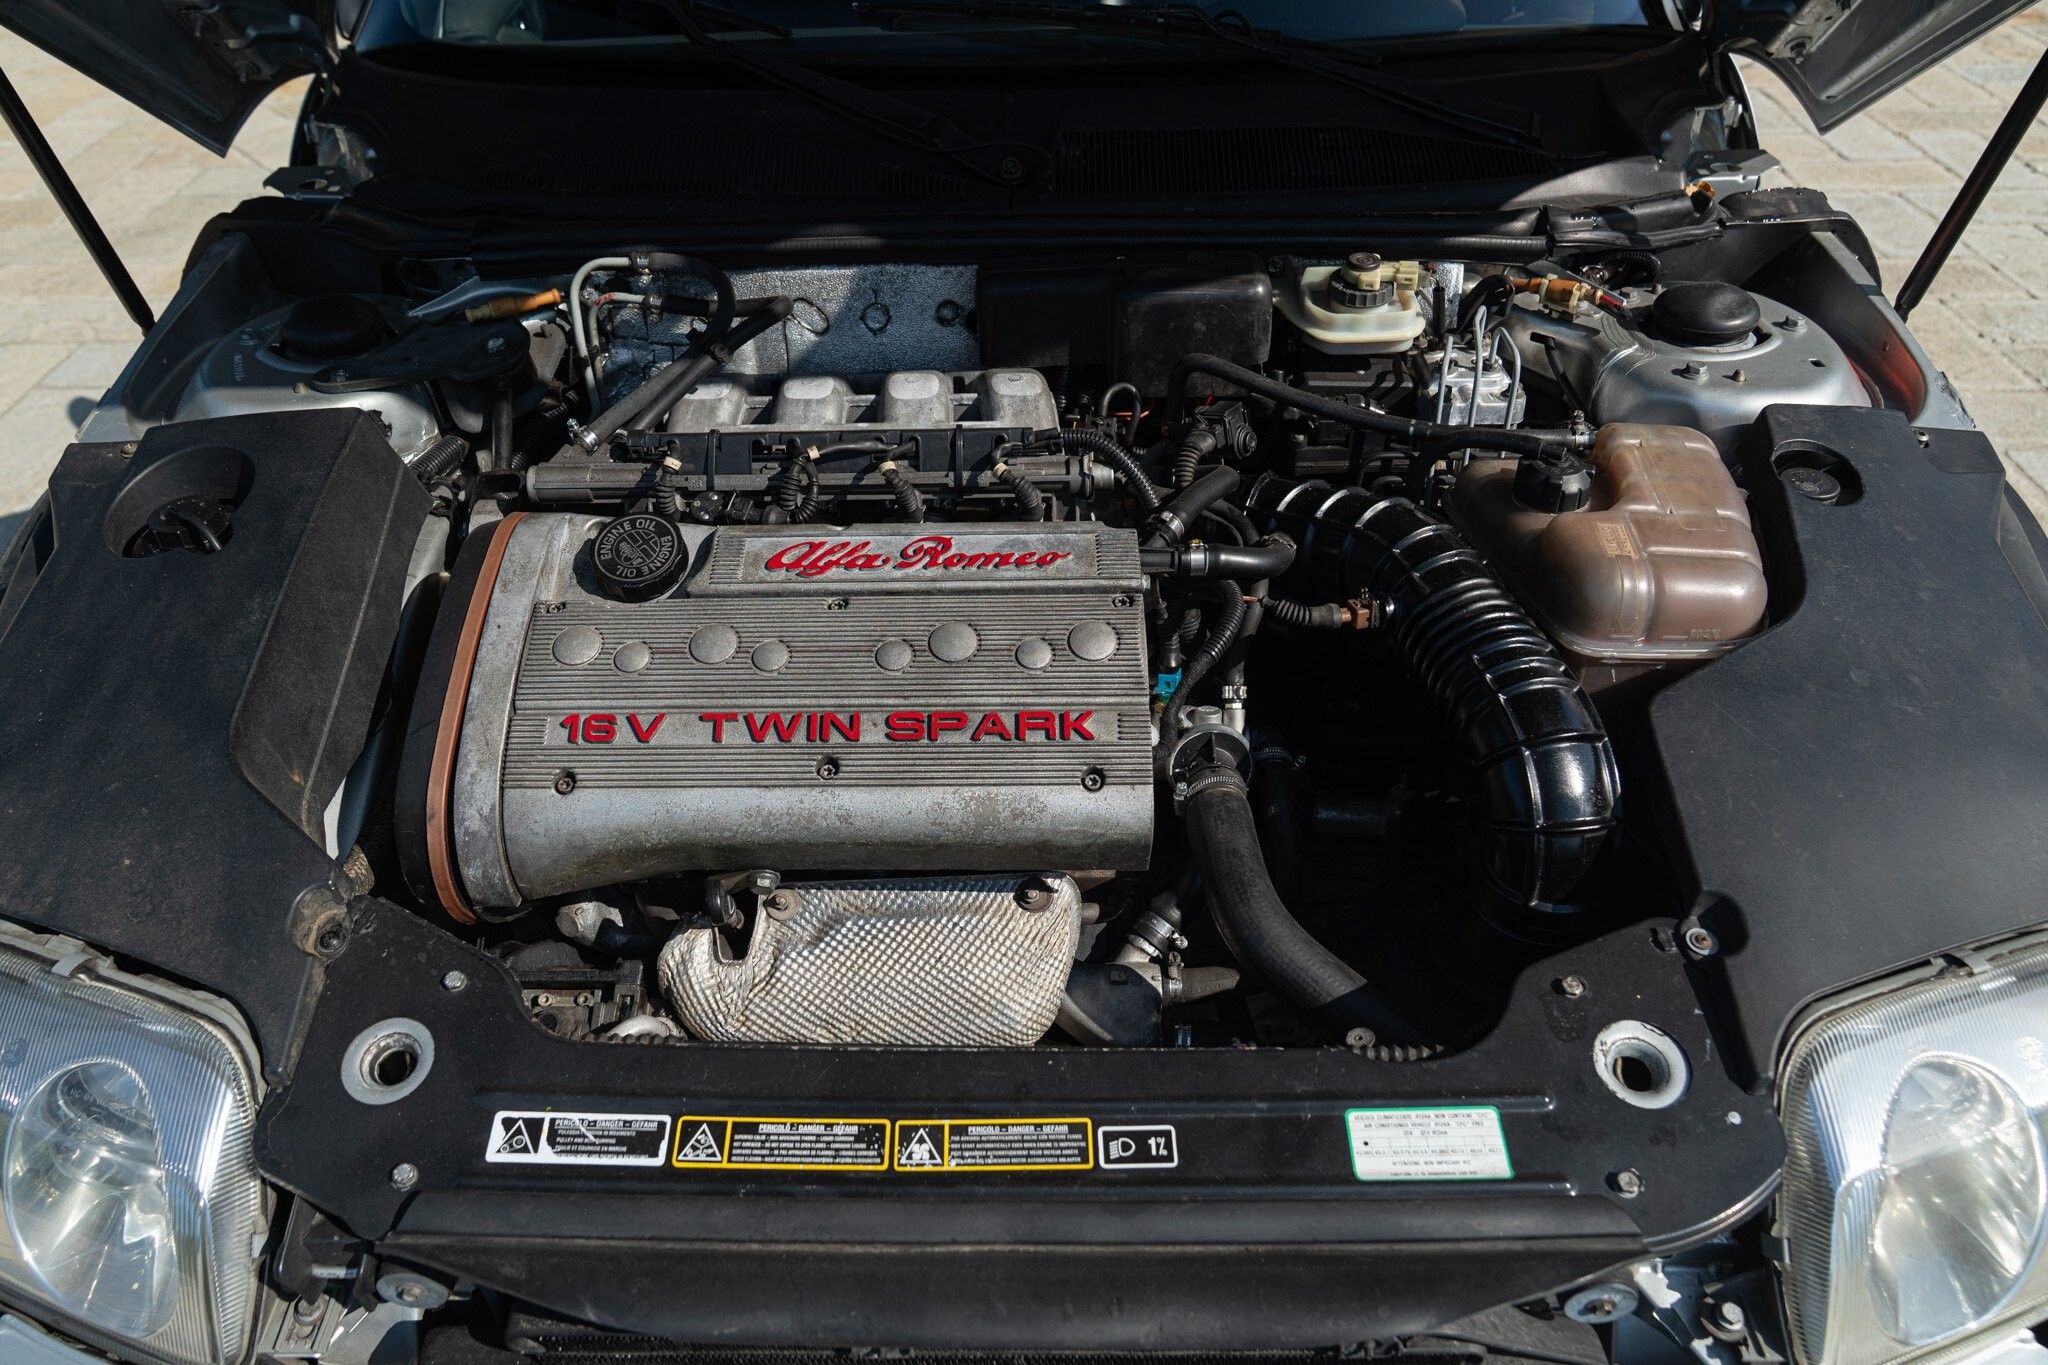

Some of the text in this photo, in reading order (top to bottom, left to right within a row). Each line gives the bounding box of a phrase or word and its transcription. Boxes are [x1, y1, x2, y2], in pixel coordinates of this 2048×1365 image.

[600, 521, 632, 560] ENGINE
[636, 519, 656, 531] OIL
[641, 535, 672, 576] ENGINE
[764, 535, 1072, 577] Alfa Romeo
[616, 565, 636, 577] OIL
[699, 711, 861, 743] TWIN
[885, 710, 1096, 743] SPARK
[596, 1120, 623, 1128] DANGER
[631, 1120, 658, 1129] GEFAHR
[758, 1123, 790, 1132] PERICOLO
[798, 1124, 825, 1132] DANGER
[968, 1125, 1000, 1133] PERICOLO
[1043, 1124, 1068, 1132] GEFAHR
